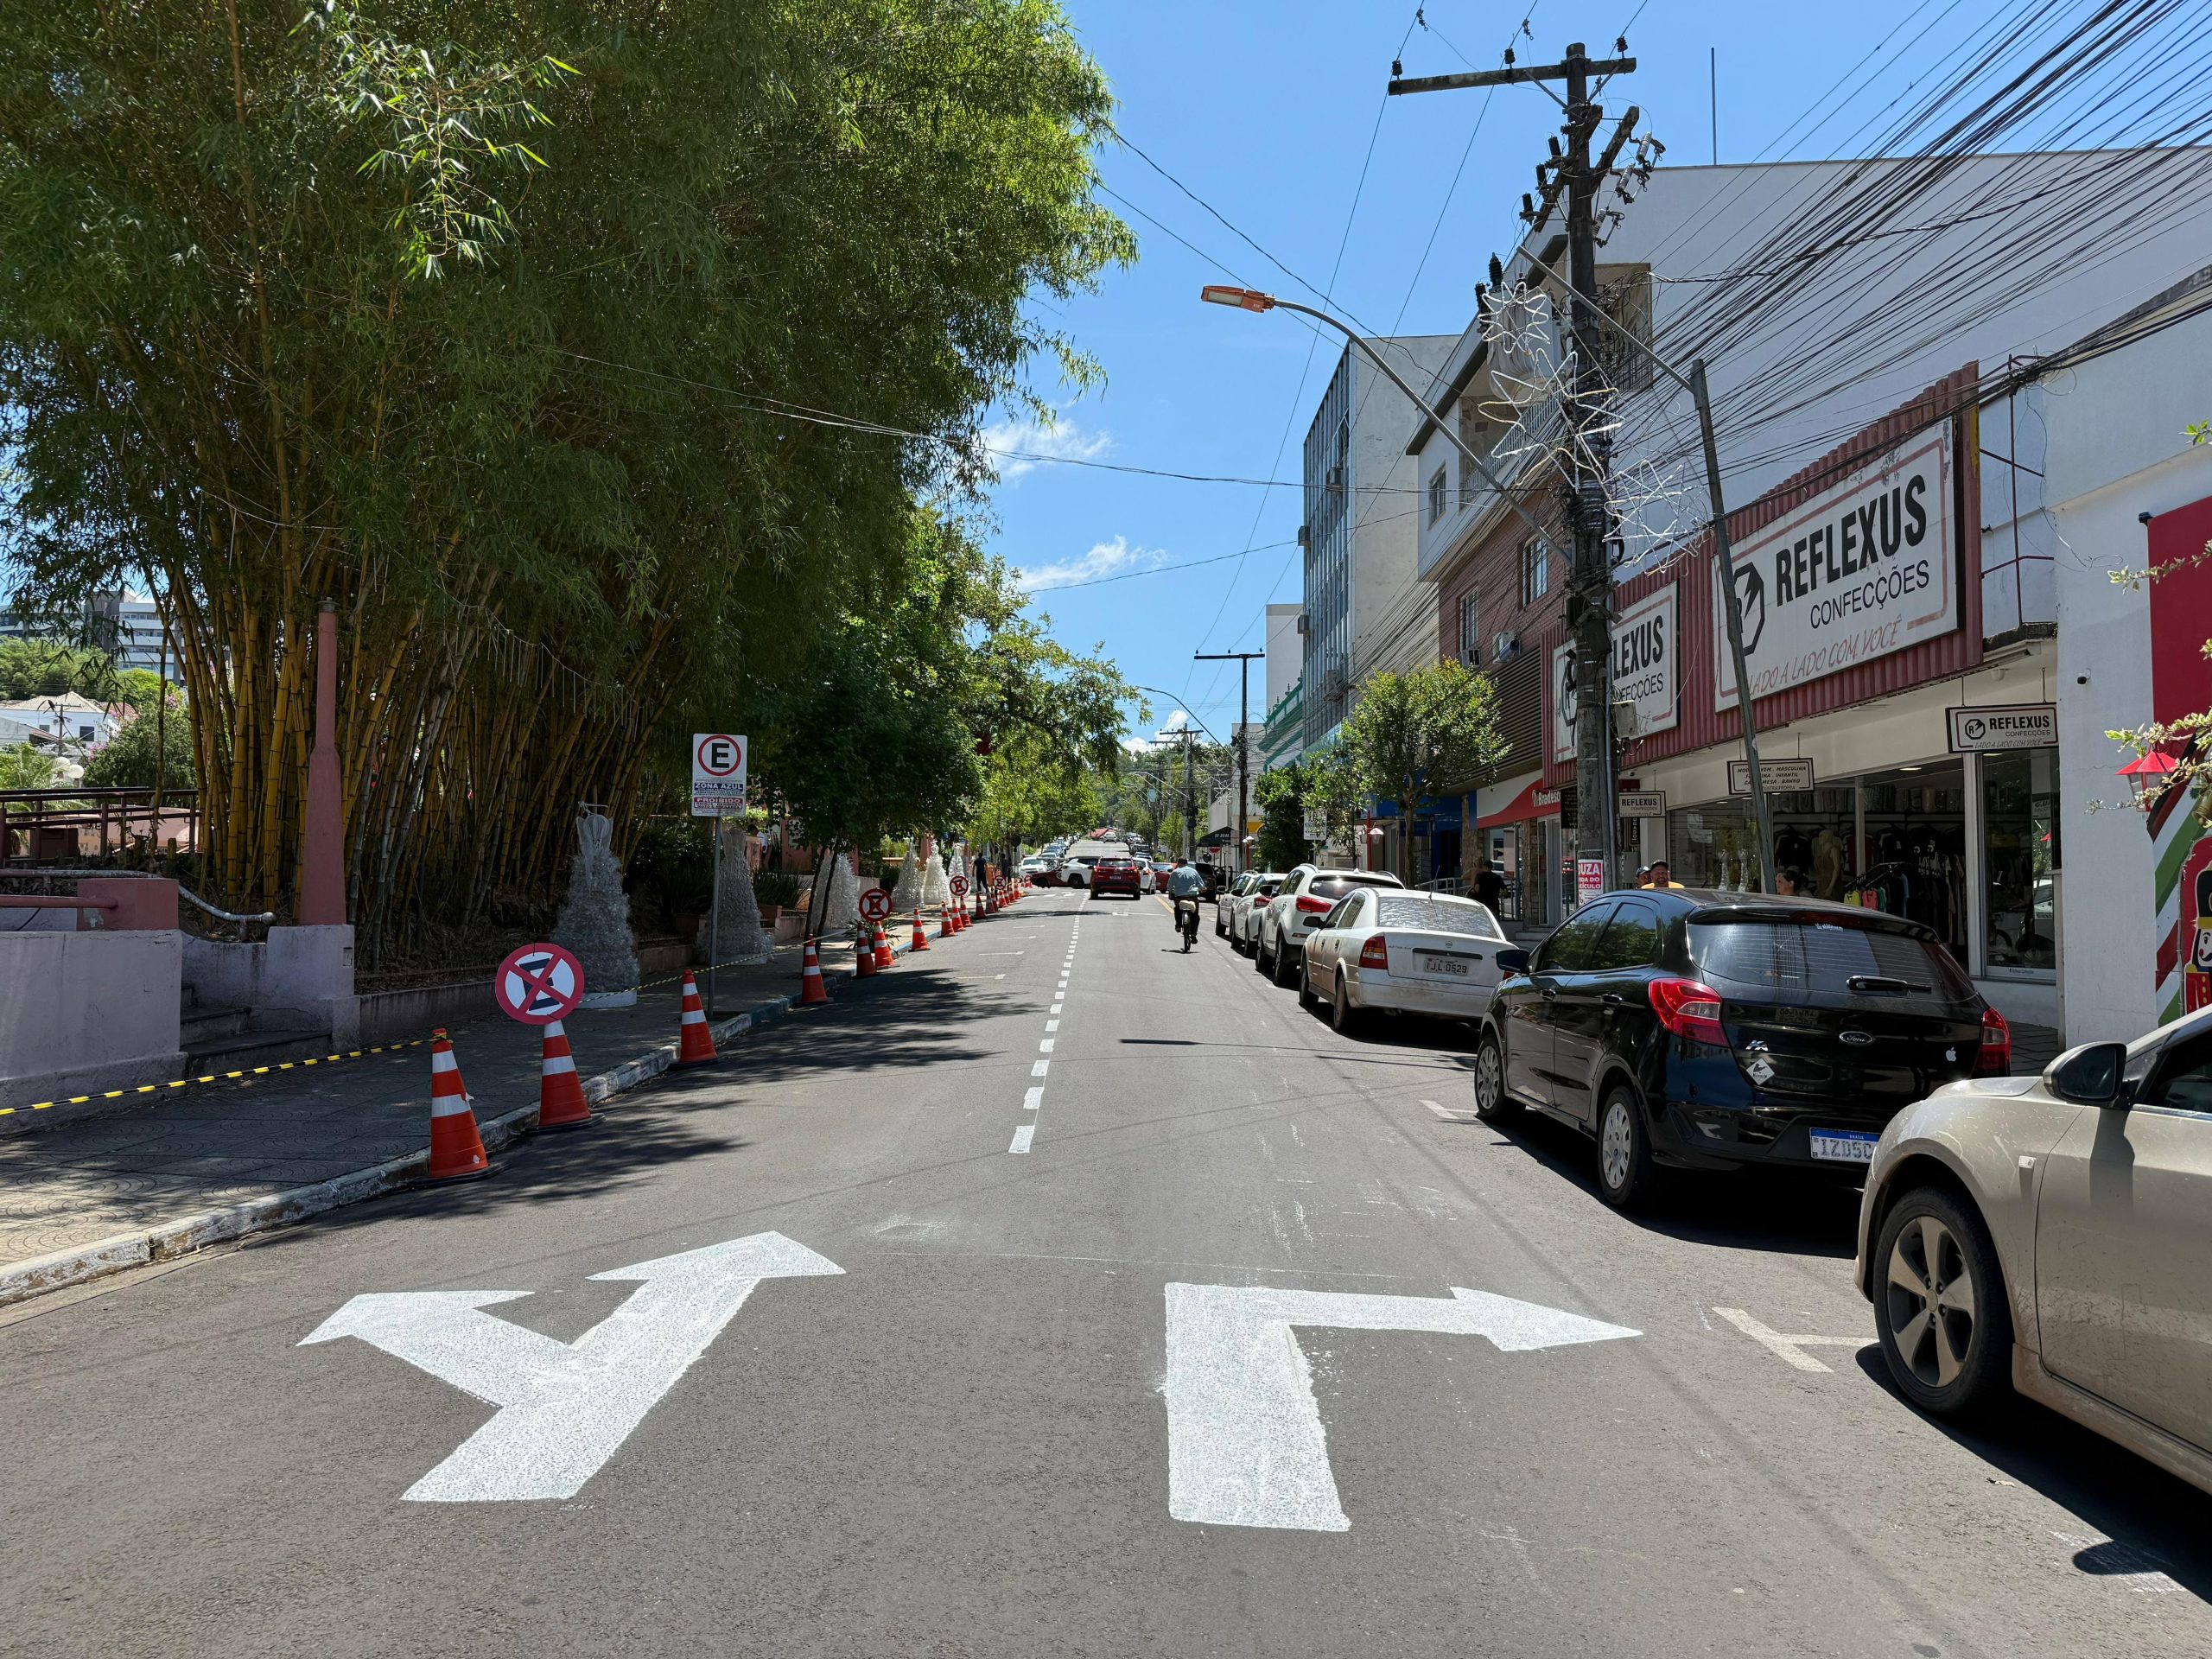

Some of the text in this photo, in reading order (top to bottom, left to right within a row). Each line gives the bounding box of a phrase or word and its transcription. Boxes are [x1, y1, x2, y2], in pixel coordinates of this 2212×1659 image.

[1776, 474, 1927, 607] REFLEXUS
[1810, 559, 1929, 629] CONFECÇÕES
[1613, 614, 1664, 681] LEXUS
[1780, 664, 1792, 686] A
[1791, 646, 1827, 681] LADO
[1828, 636, 1859, 669] COM
[1862, 614, 1904, 655] VOCÊ
[1989, 715, 2050, 730] REFLEXUS
[2005, 729, 2051, 738] CONFECÇÕES
[1996, 740, 2012, 748] LADO
[2026, 738, 2042, 747] VOCÊ
[711, 742, 730, 769] E
[721, 782, 743, 791] AZUL
[1538, 790, 1561, 806] Bradesc
[1621, 798, 1658, 807] REFLEXUS
[1821, 1139, 1872, 1160] IZD5C
